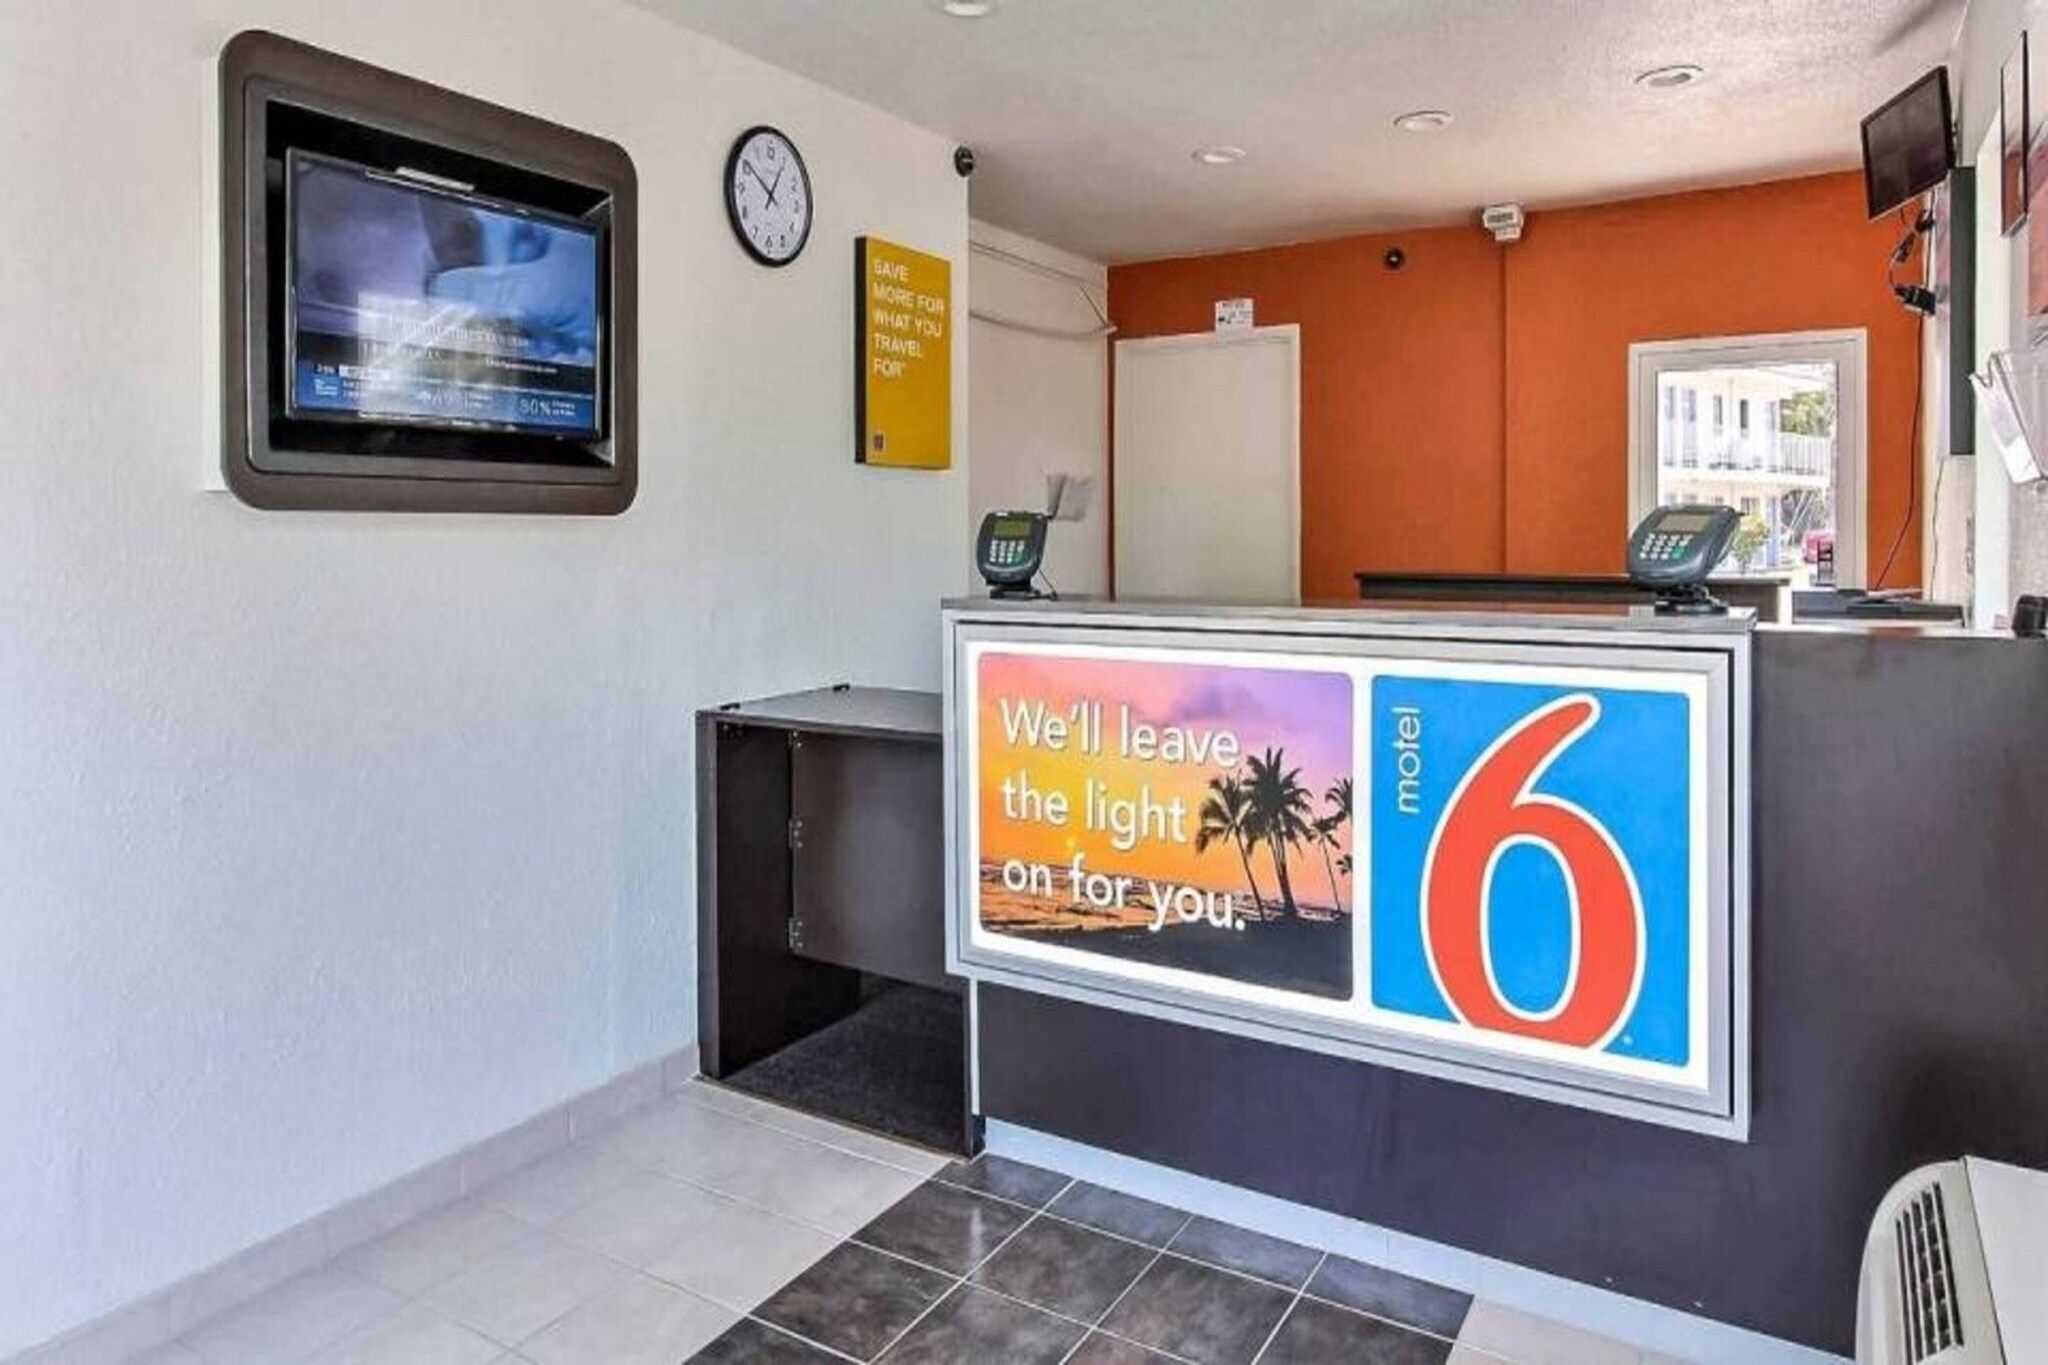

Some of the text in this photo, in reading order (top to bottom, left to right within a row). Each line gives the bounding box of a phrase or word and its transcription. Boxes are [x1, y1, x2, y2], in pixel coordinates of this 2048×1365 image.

[873, 281, 945, 316] MORE FOR
[874, 260, 909, 281] SAVE
[873, 309, 943, 338] WHAT YOU
[873, 332, 922, 358] TRAVEL
[1000, 697, 1240, 768] We'll leave
[1391, 706, 1421, 814] motel
[1001, 769, 1188, 851] the light
[1003, 850, 1246, 931] on for you.
[1419, 691, 1648, 1051] 6
